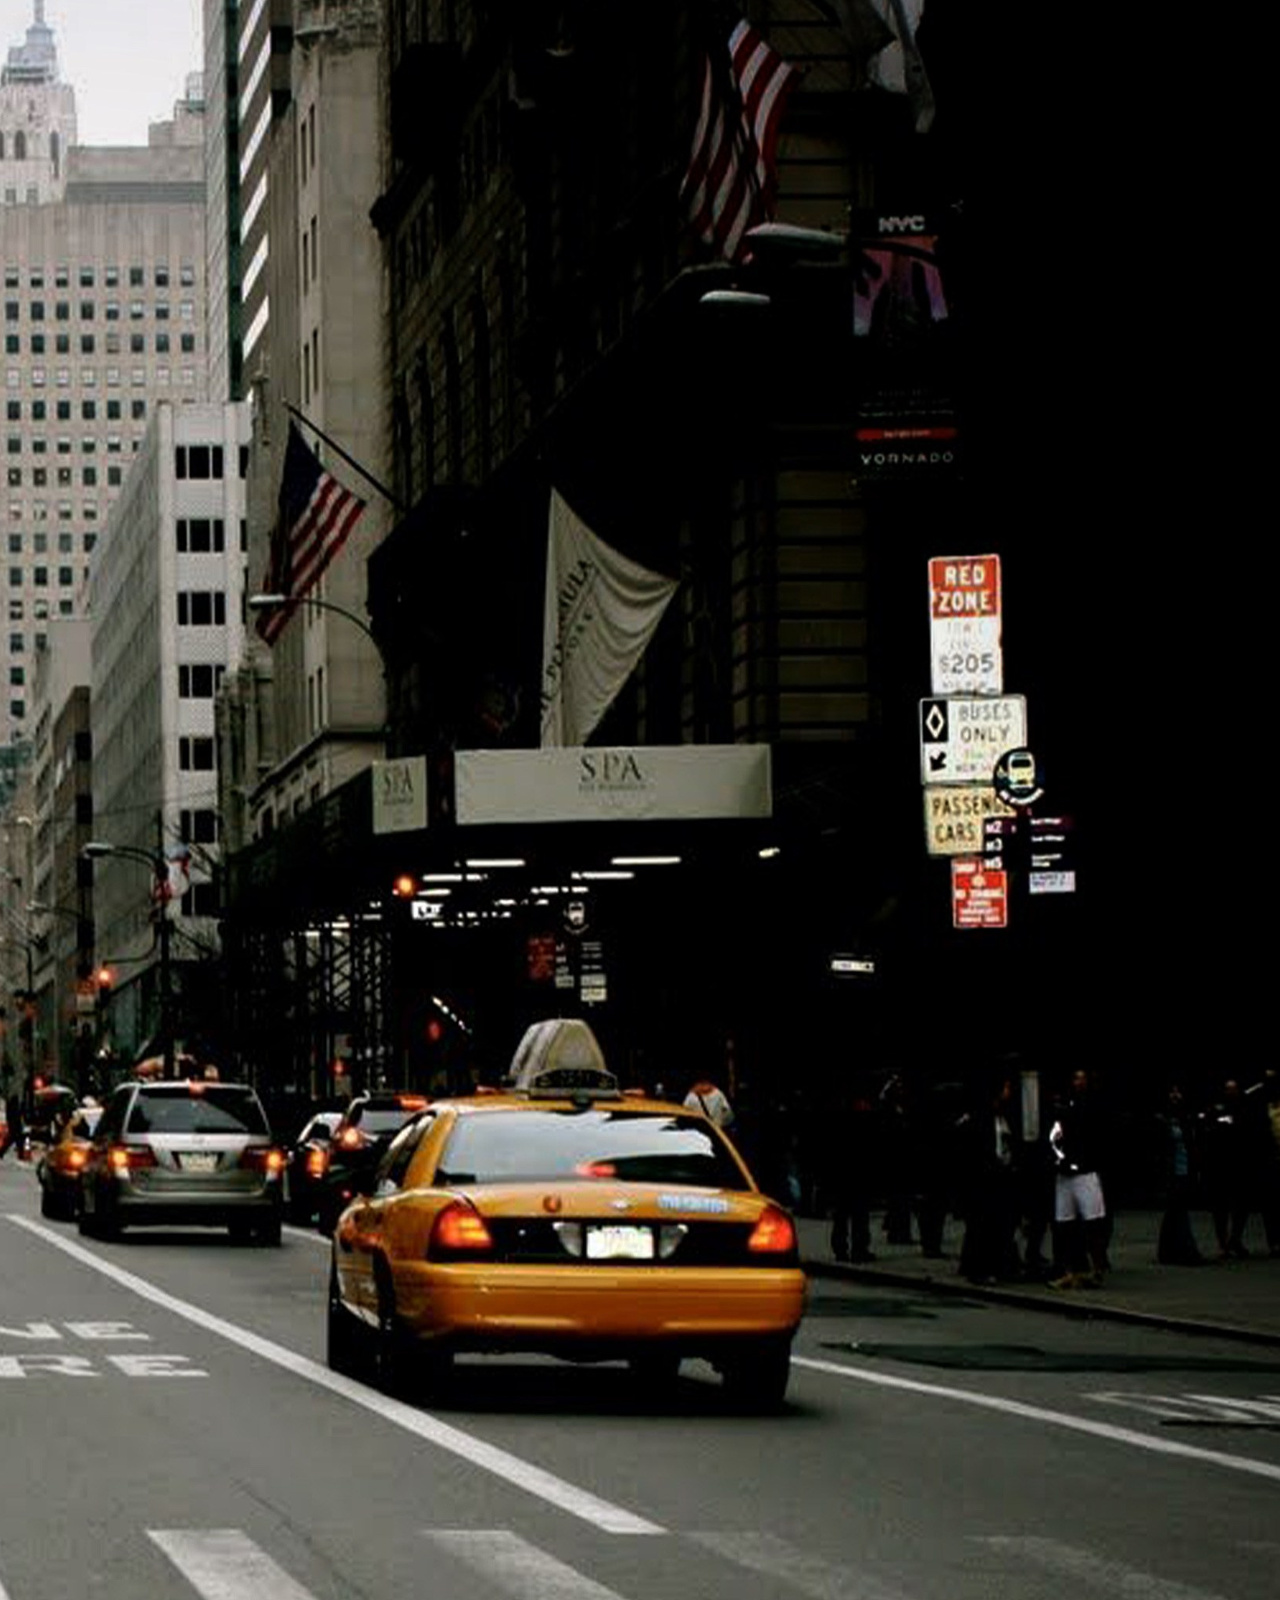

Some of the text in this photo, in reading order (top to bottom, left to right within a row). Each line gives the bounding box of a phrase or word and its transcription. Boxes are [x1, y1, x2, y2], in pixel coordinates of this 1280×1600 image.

[878, 215, 925, 232] NYC
[944, 564, 986, 587] RED
[938, 590, 992, 613] ZONE
[939, 652, 995, 675] $205
[958, 703, 1012, 721] BUSES
[960, 724, 1011, 743] ONLY
[383, 763, 414, 794] SPA
[580, 752, 642, 782] SPA
[934, 822, 976, 843] CARS
